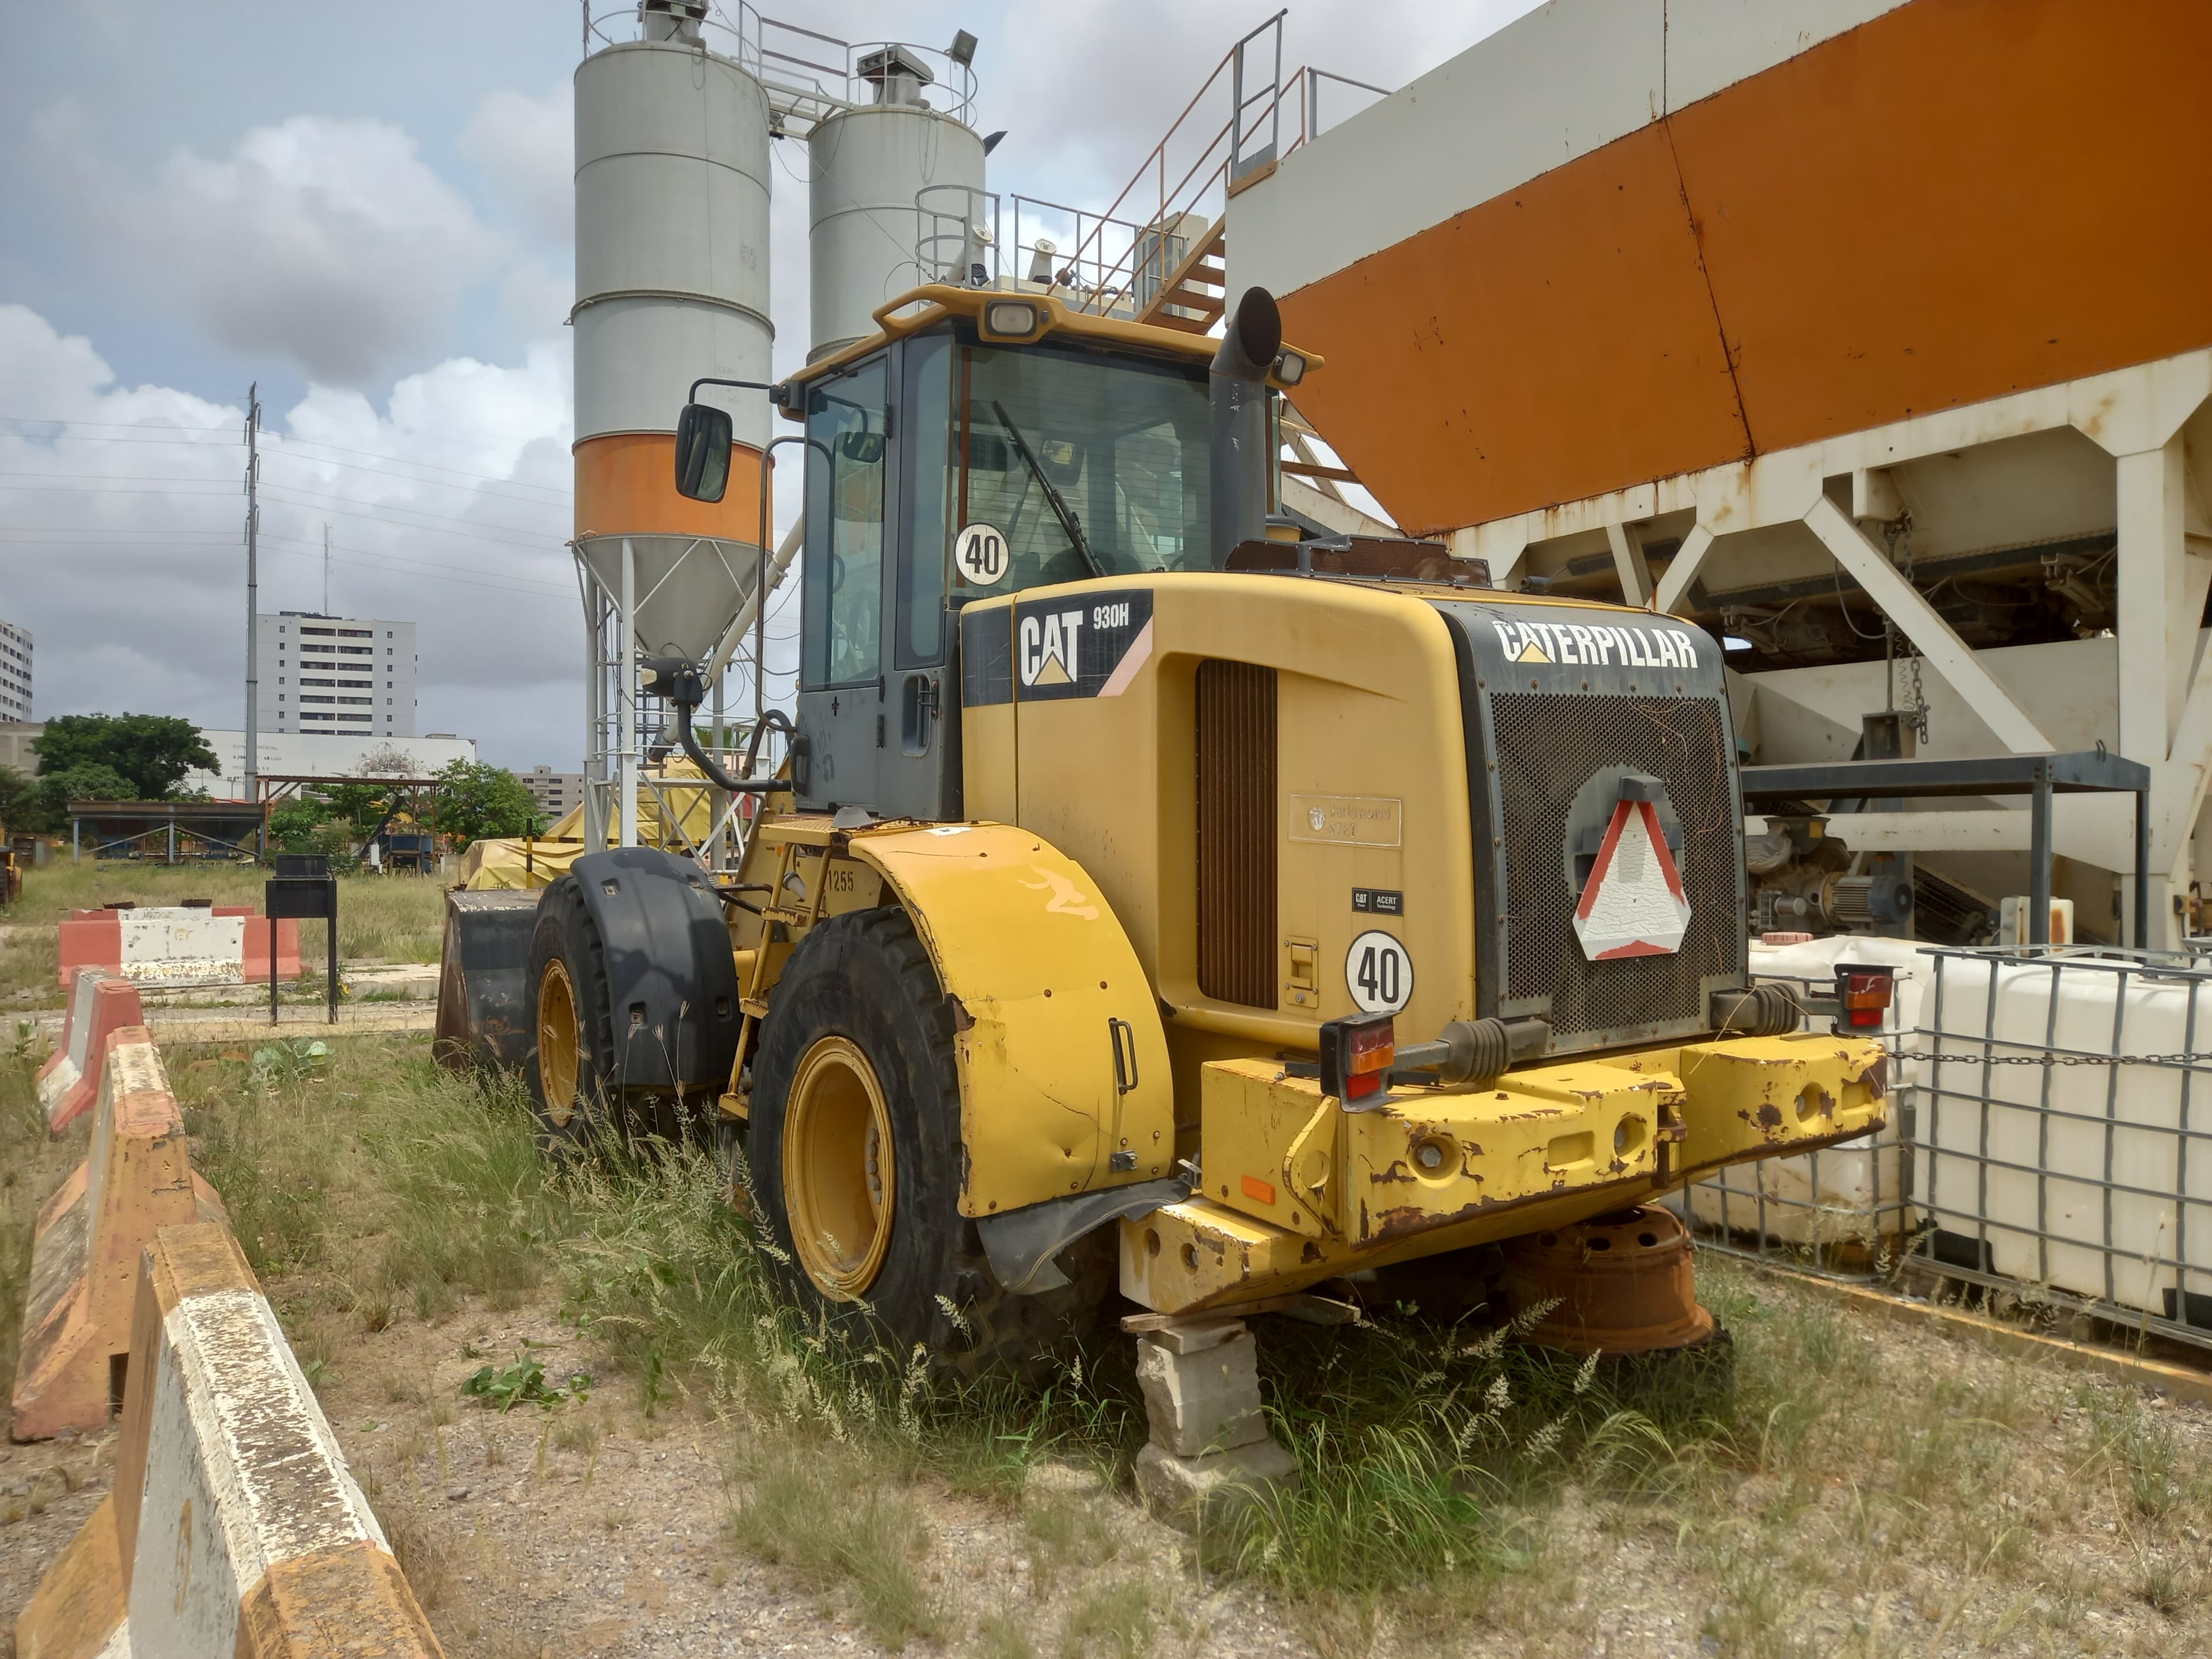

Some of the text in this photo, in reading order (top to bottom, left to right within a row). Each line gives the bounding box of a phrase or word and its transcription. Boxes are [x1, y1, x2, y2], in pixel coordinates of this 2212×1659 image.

[964, 533, 999, 575] 40
[1020, 603, 1129, 686] CAT 930H
[1492, 620, 1699, 668] CATERPILLAR
[828, 869, 854, 892] 1255
[1355, 893, 1397, 905] CAT ACERT
[1357, 946, 1400, 1004] 40
